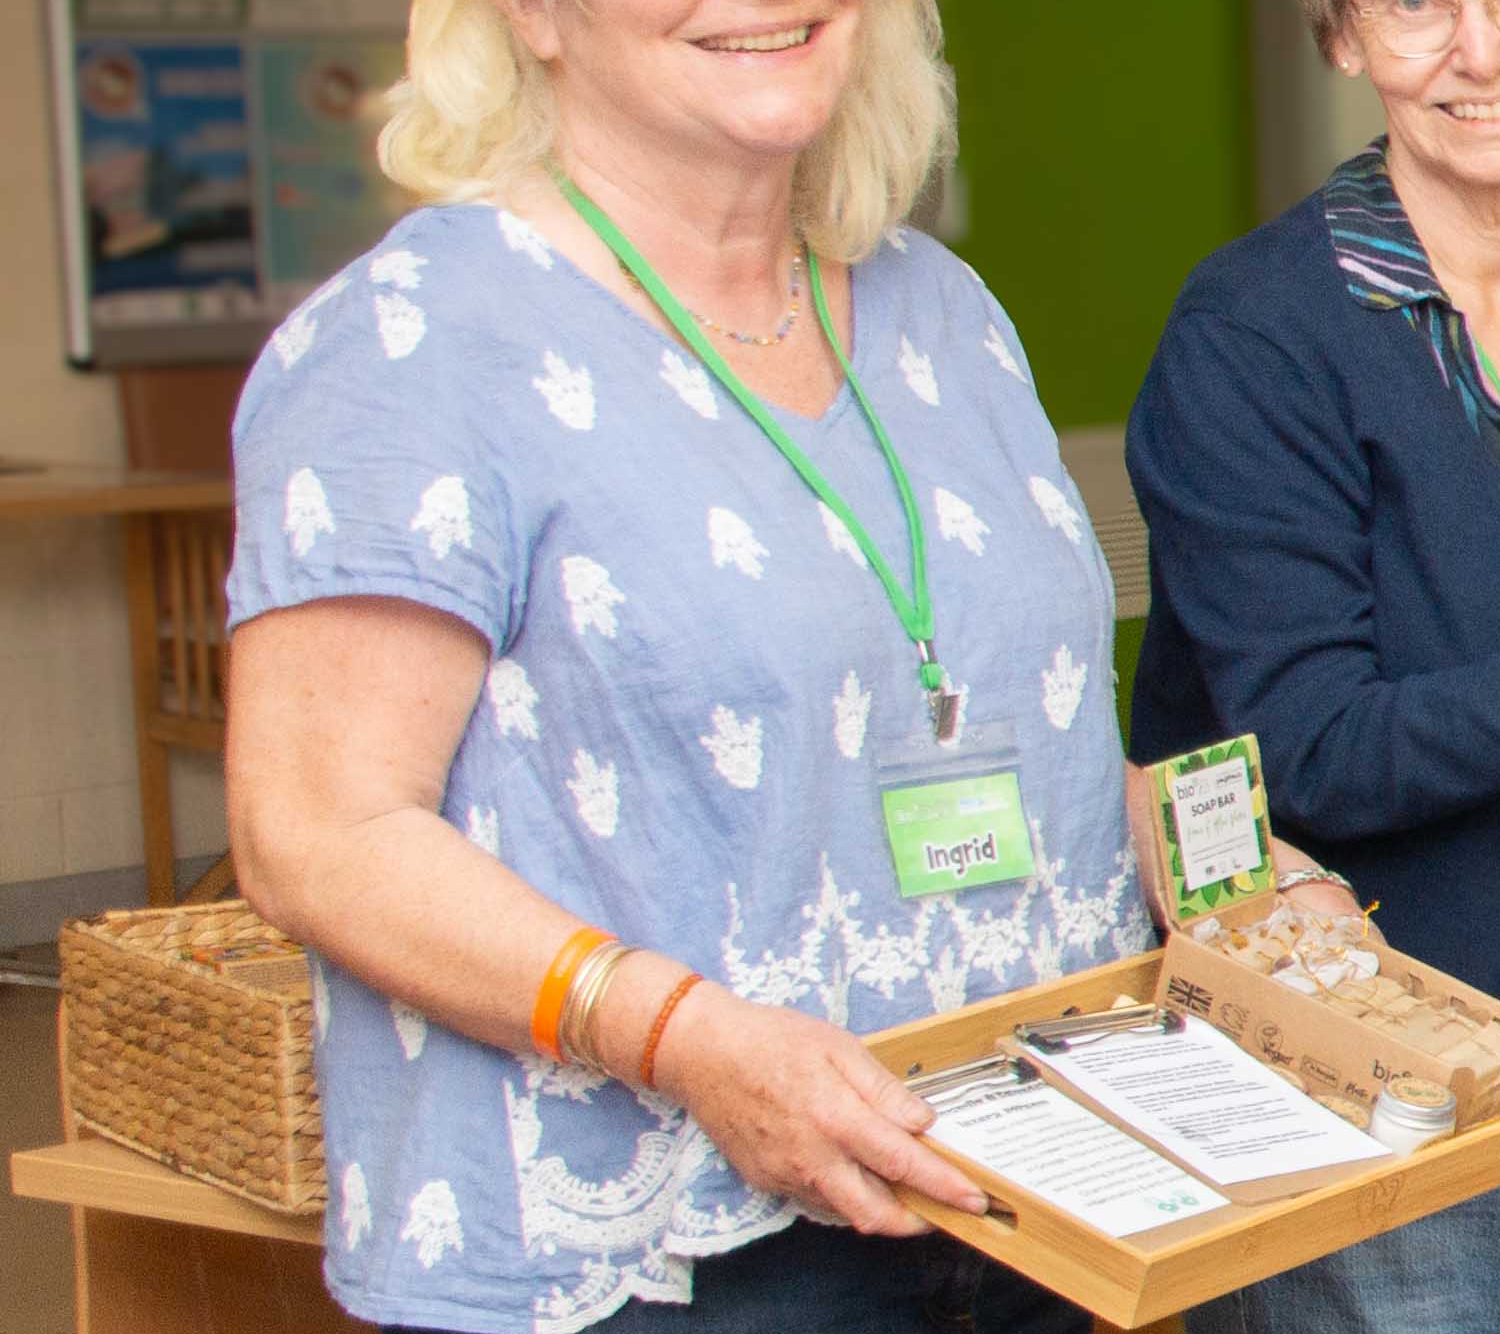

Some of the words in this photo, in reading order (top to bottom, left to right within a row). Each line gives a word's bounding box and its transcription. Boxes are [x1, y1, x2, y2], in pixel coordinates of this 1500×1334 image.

[1191, 799, 1217, 818] SOAP
[1217, 792, 1237, 811] BAR
[926, 833, 997, 875] Ingrid
